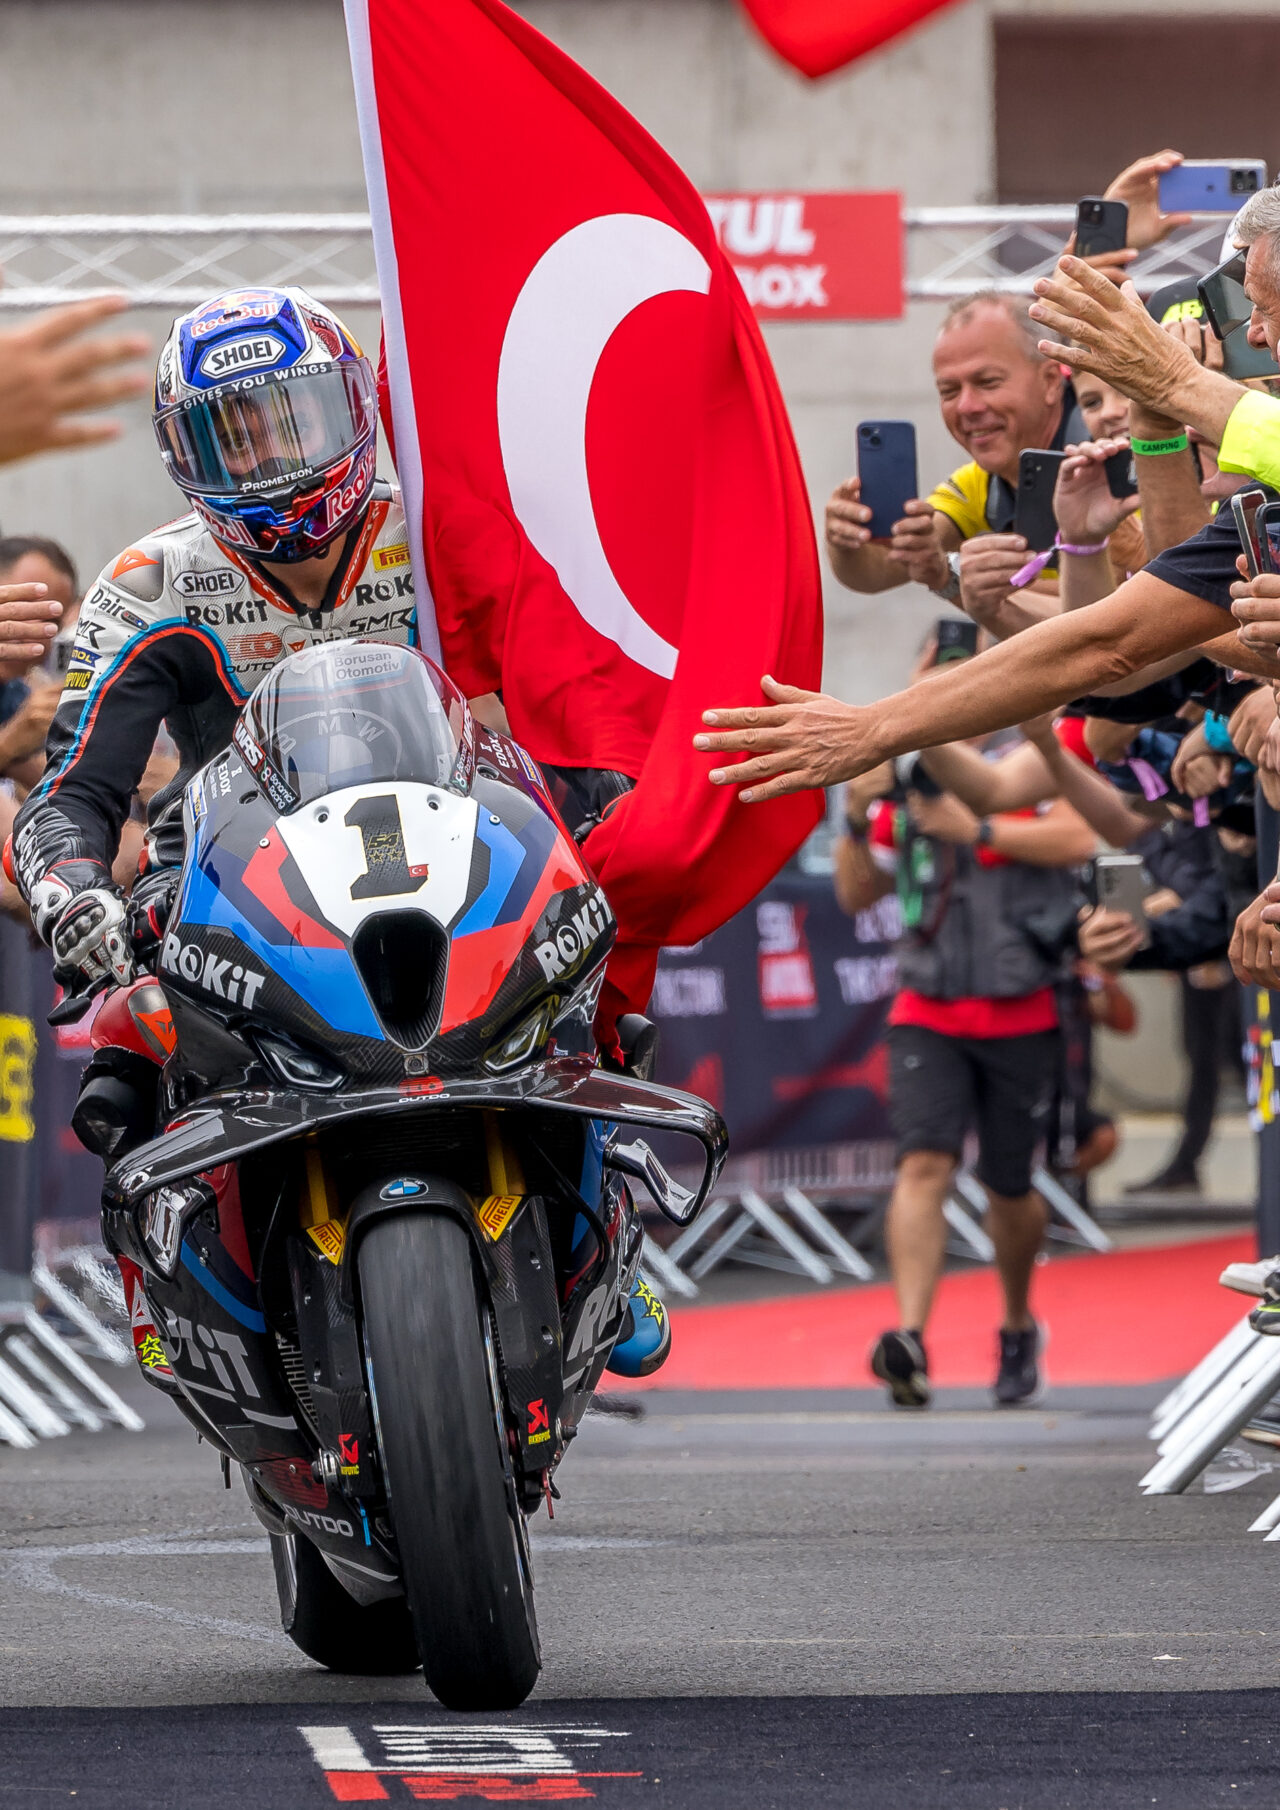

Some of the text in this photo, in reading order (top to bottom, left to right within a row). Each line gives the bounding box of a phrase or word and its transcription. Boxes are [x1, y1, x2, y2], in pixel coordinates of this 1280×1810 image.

[704, 197, 816, 257] TUL
[233, 302, 278, 321] Bull
[211, 340, 273, 371] SHOEI
[183, 363, 328, 410] GIVES YOU WINGS
[1141, 439, 1180, 452] CAMPING
[239, 466, 313, 493] PROMETEON
[326, 456, 366, 528] Red
[182, 572, 236, 593] SHOEI
[355, 573, 415, 606] ROK
[185, 600, 268, 626] ROKiT
[224, 661, 276, 674] OUTD
[334, 652, 392, 668] Borusan
[336, 662, 400, 680] Otomotiv
[234, 722, 264, 767] WRS
[489, 736, 510, 769] EDOX
[218, 762, 232, 797] EDOX
[270, 773, 295, 803] Bonamici
[268, 785, 286, 809] Racing
[343, 793, 428, 901] 1
[368, 832, 400, 849] 54
[534, 886, 614, 983] ROKiT
[161, 932, 266, 1010] ROKiT
[399, 1093, 450, 1103] OUTDO
[482, 1196, 516, 1232] PIRELLI
[314, 1222, 342, 1257] PIRELLI
[280, 1503, 354, 1537] OUTDO
